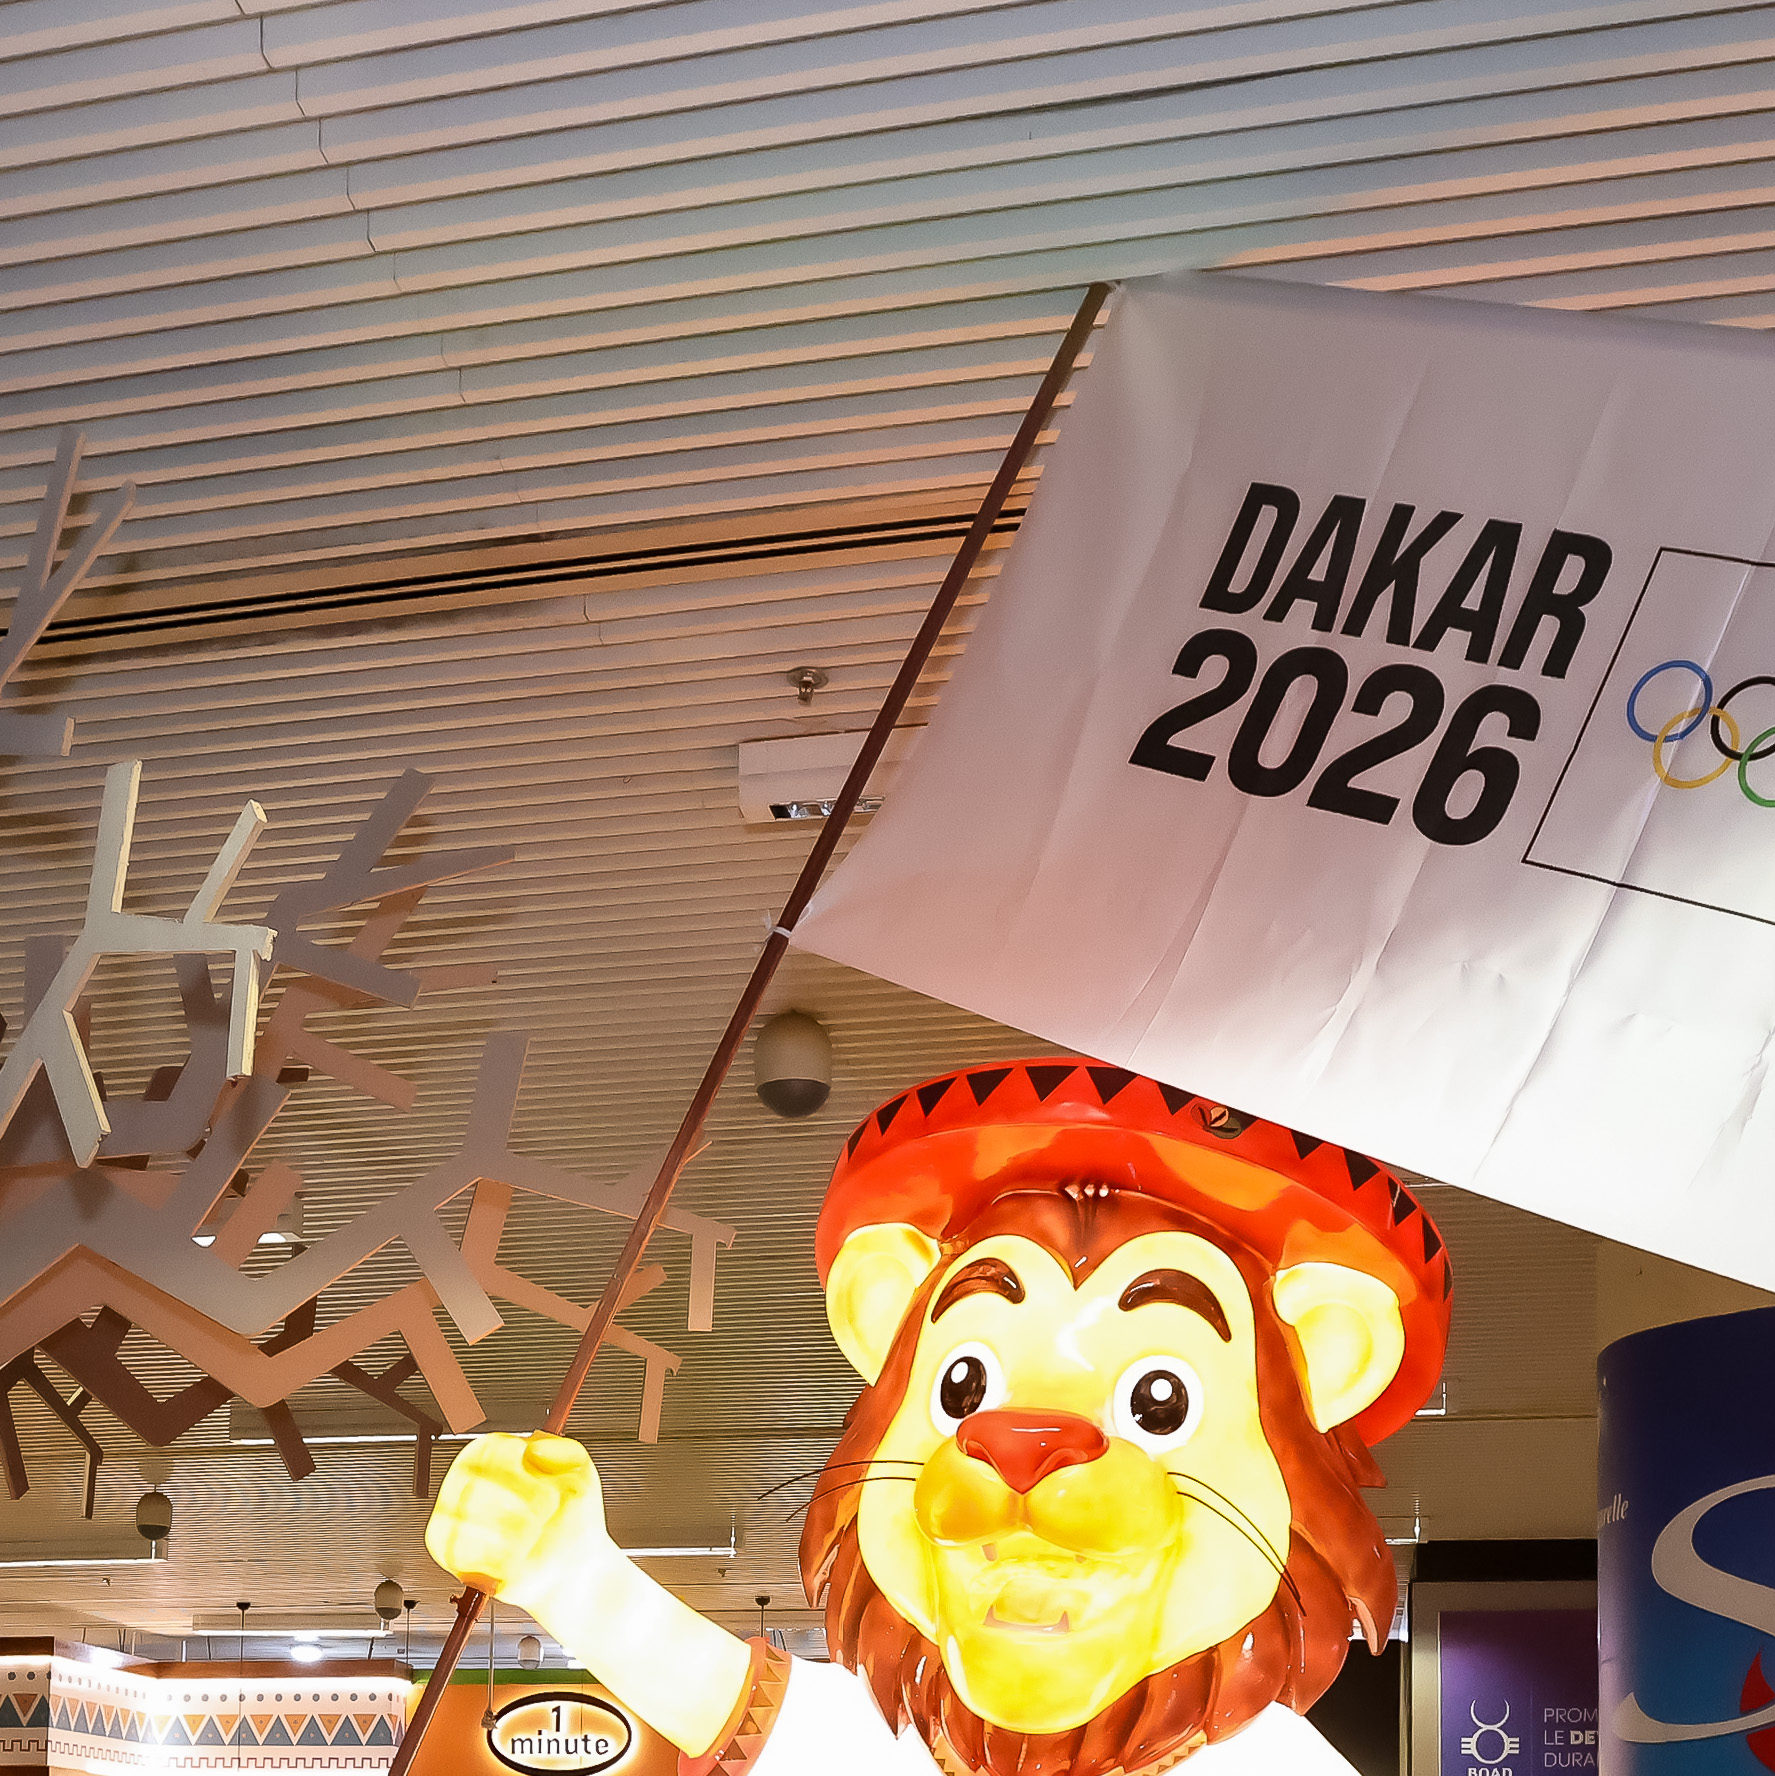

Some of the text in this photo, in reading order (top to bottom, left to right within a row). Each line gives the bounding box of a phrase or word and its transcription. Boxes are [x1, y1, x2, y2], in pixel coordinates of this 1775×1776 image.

[1199, 481, 1613, 680] DAKAR
[1128, 628, 1542, 846] 2026
[551, 1705, 561, 1732] 1
[510, 1729, 609, 1755] minute
[1543, 1730, 1564, 1745] LE
